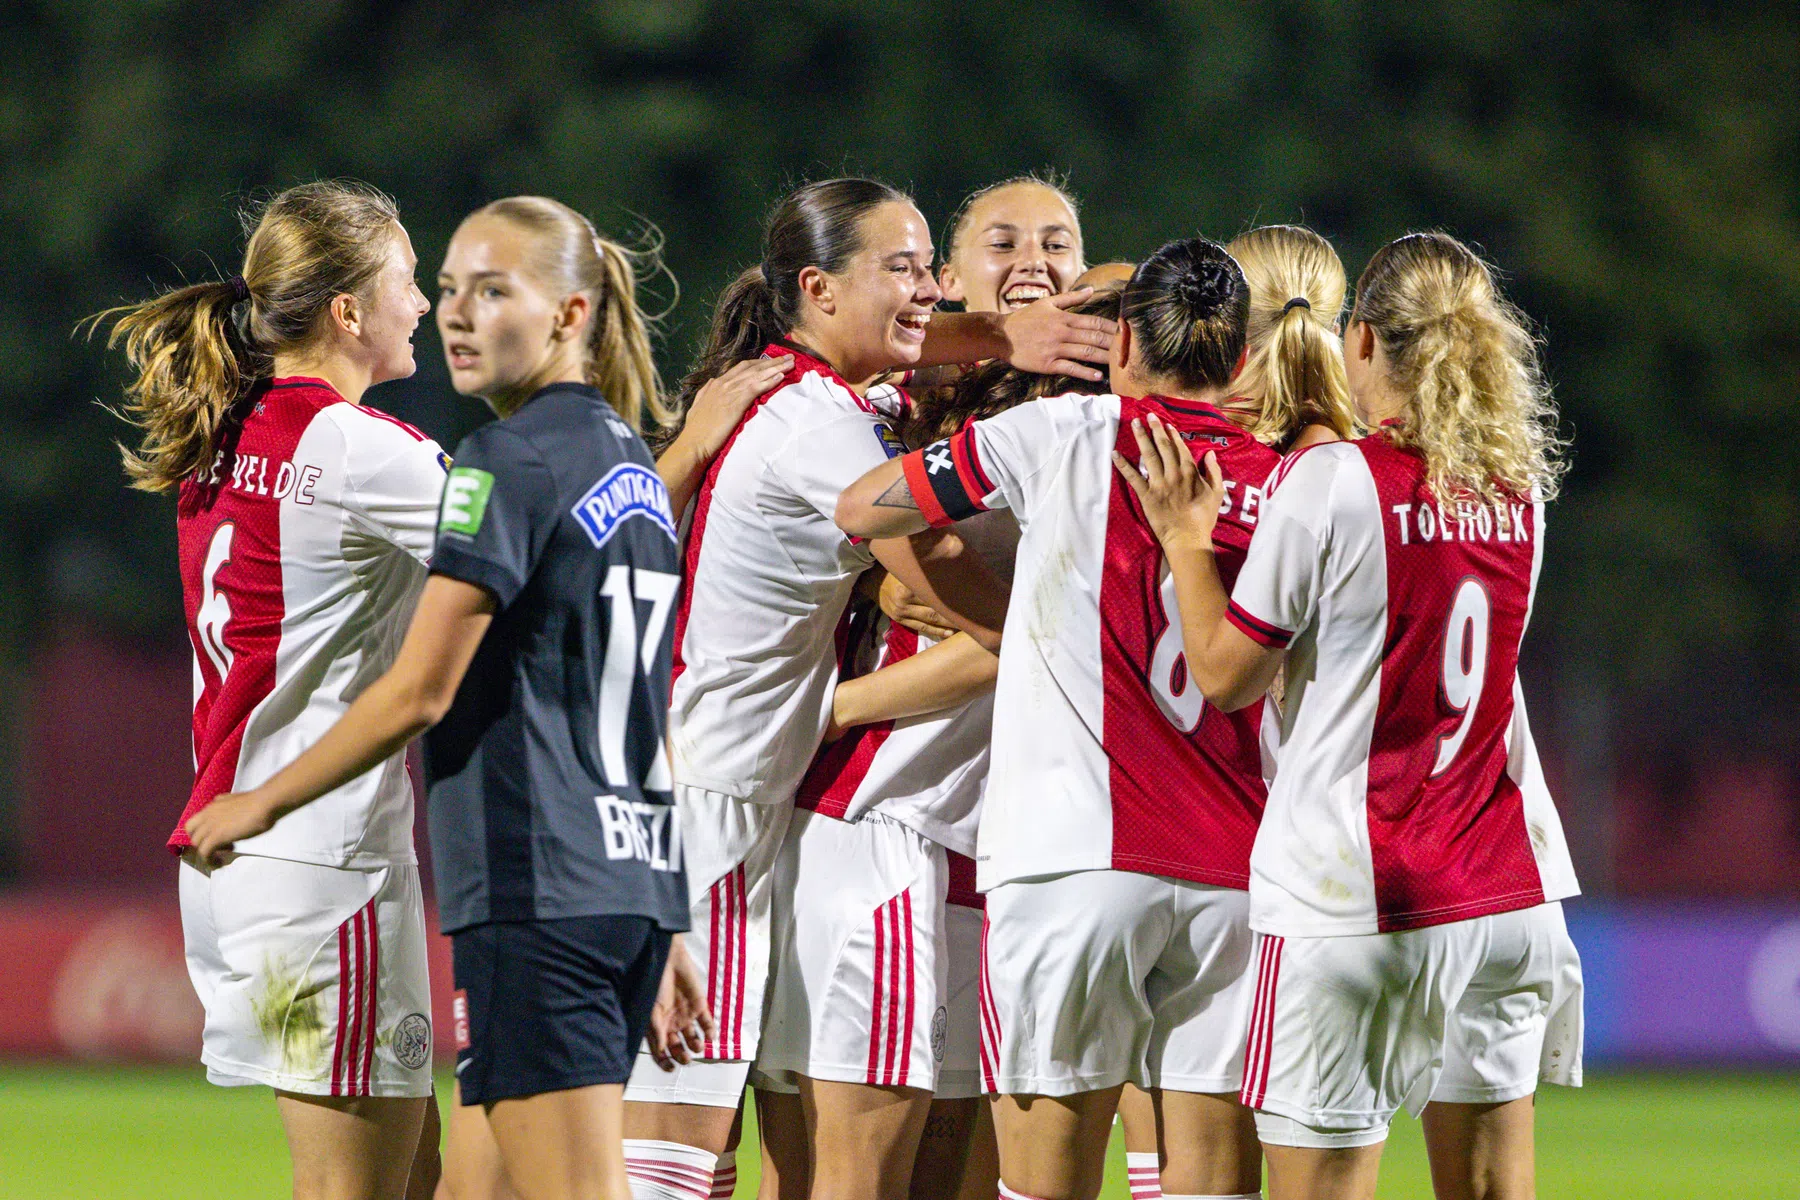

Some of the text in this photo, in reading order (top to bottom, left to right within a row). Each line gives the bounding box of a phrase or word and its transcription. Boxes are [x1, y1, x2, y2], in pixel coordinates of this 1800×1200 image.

[232, 453, 322, 505] VELDE
[441, 475, 480, 524] E
[1392, 502, 1528, 545] TOLHOEK
[196, 518, 236, 686] 6
[599, 565, 681, 792] 17
[1429, 575, 1493, 778] 9
